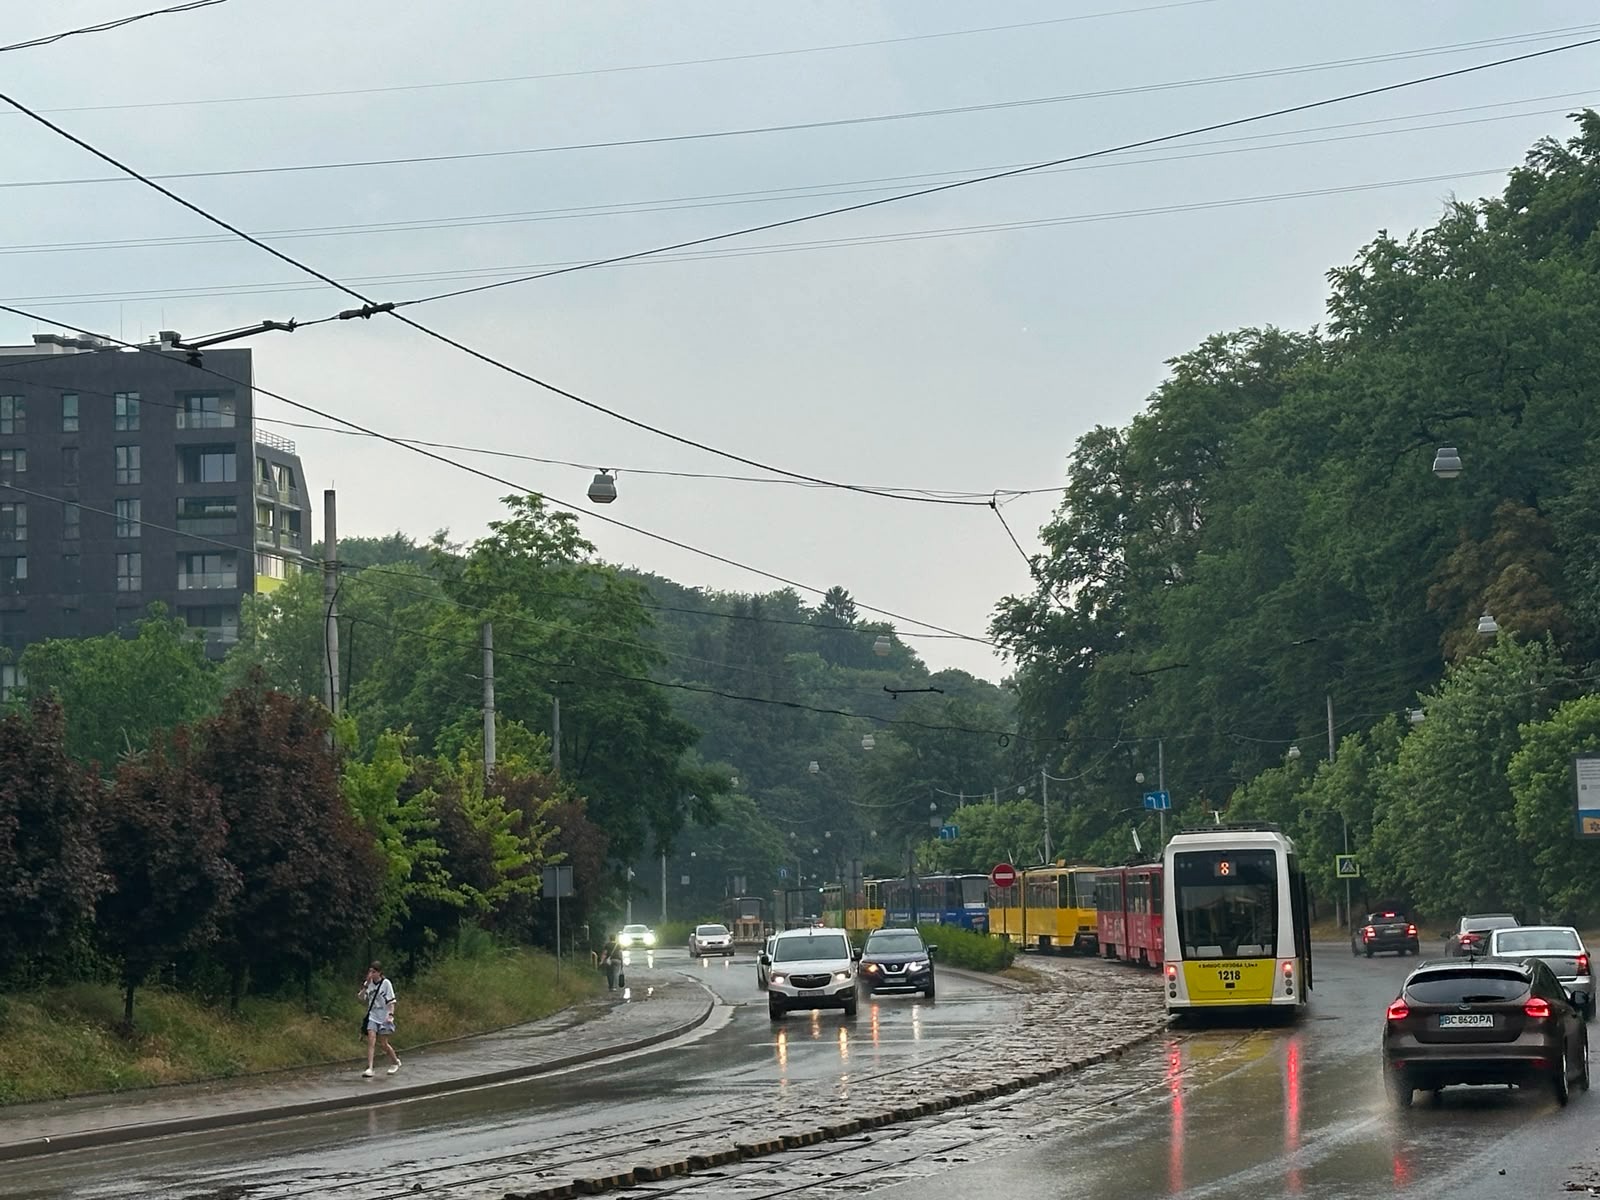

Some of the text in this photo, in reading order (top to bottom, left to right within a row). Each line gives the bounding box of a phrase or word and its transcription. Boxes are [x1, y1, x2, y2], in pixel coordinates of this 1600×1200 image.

[1220, 862, 1229, 875] 8
[1217, 970, 1241, 981] 1218
[1444, 1015, 1492, 1024] BC 8620 PA
